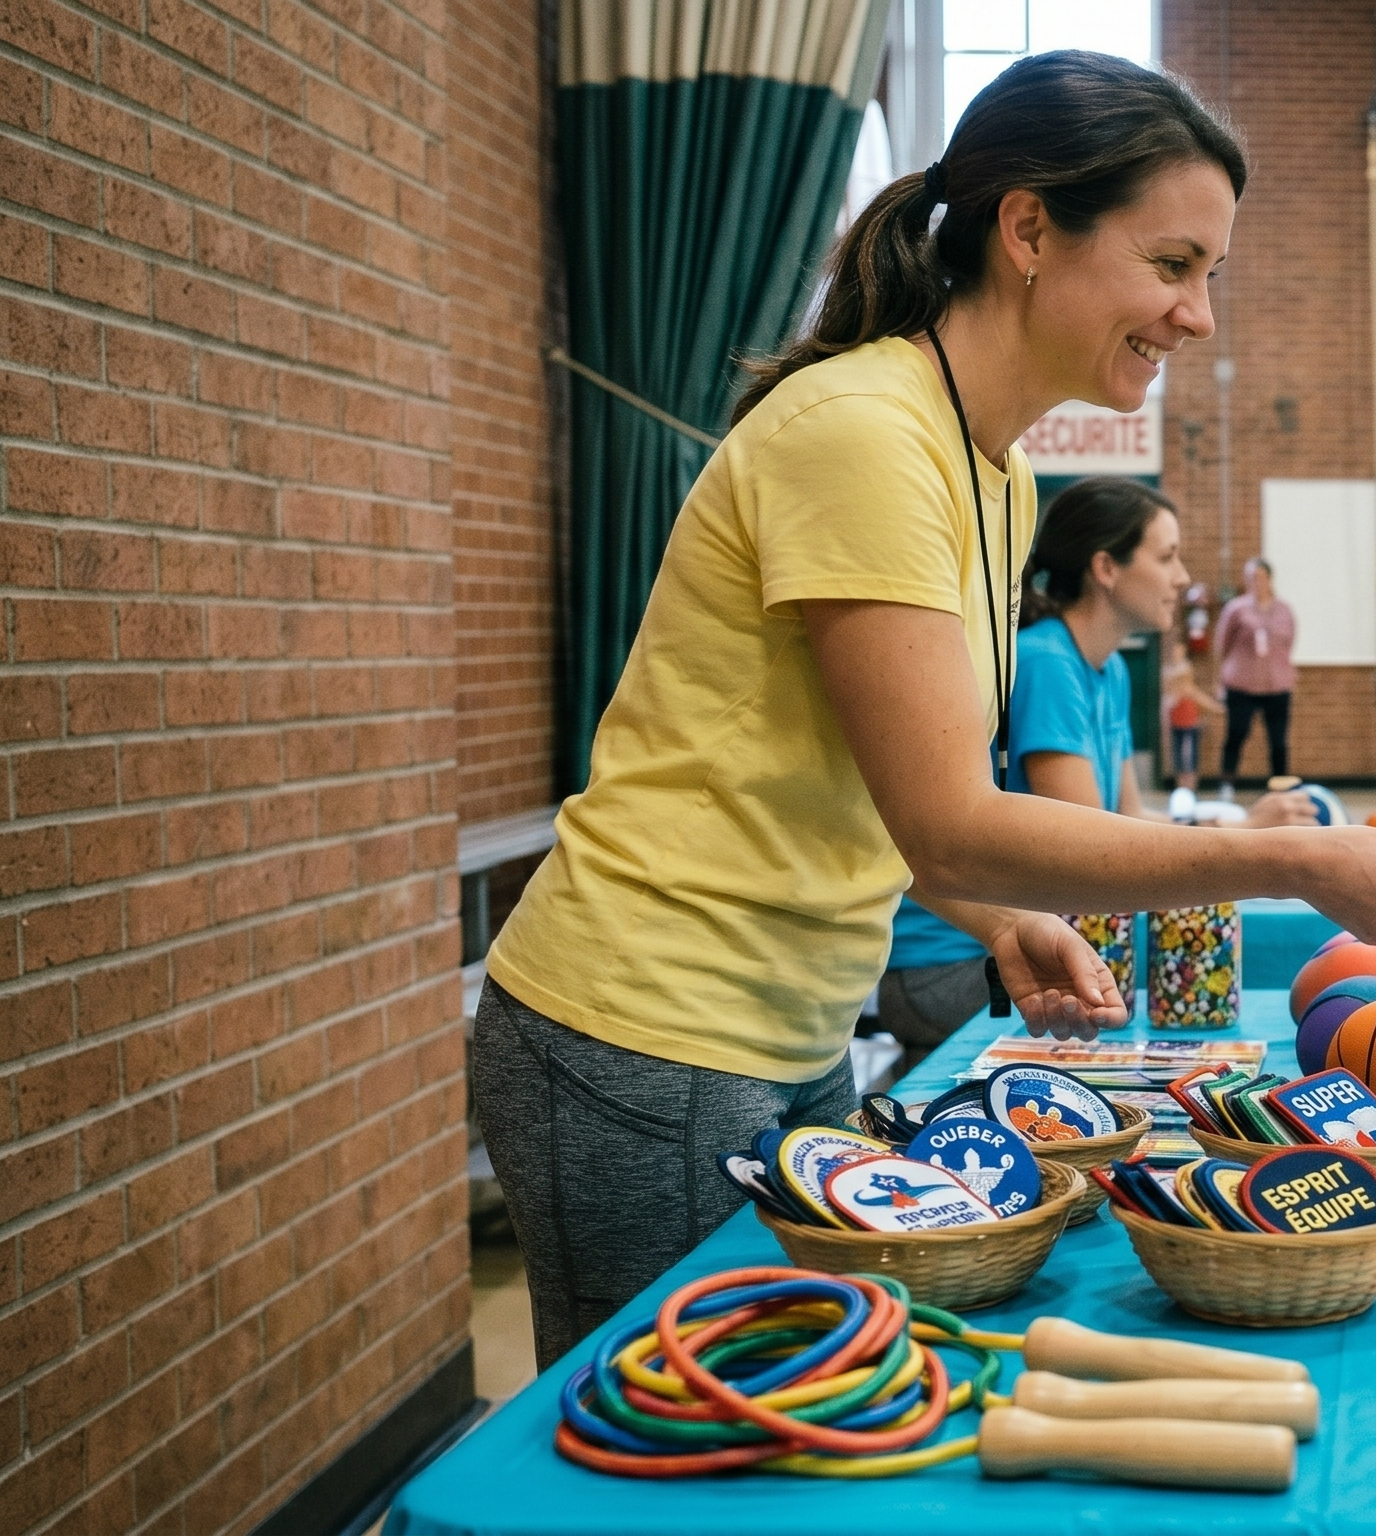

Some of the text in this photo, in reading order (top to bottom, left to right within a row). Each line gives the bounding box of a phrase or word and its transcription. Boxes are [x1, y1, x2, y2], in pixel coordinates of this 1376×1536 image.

[1291, 1079, 1365, 1118] SUPER
[1260, 1161, 1353, 1212] ESPRIT
[1284, 1187, 1376, 1234] ÉQUIPE
